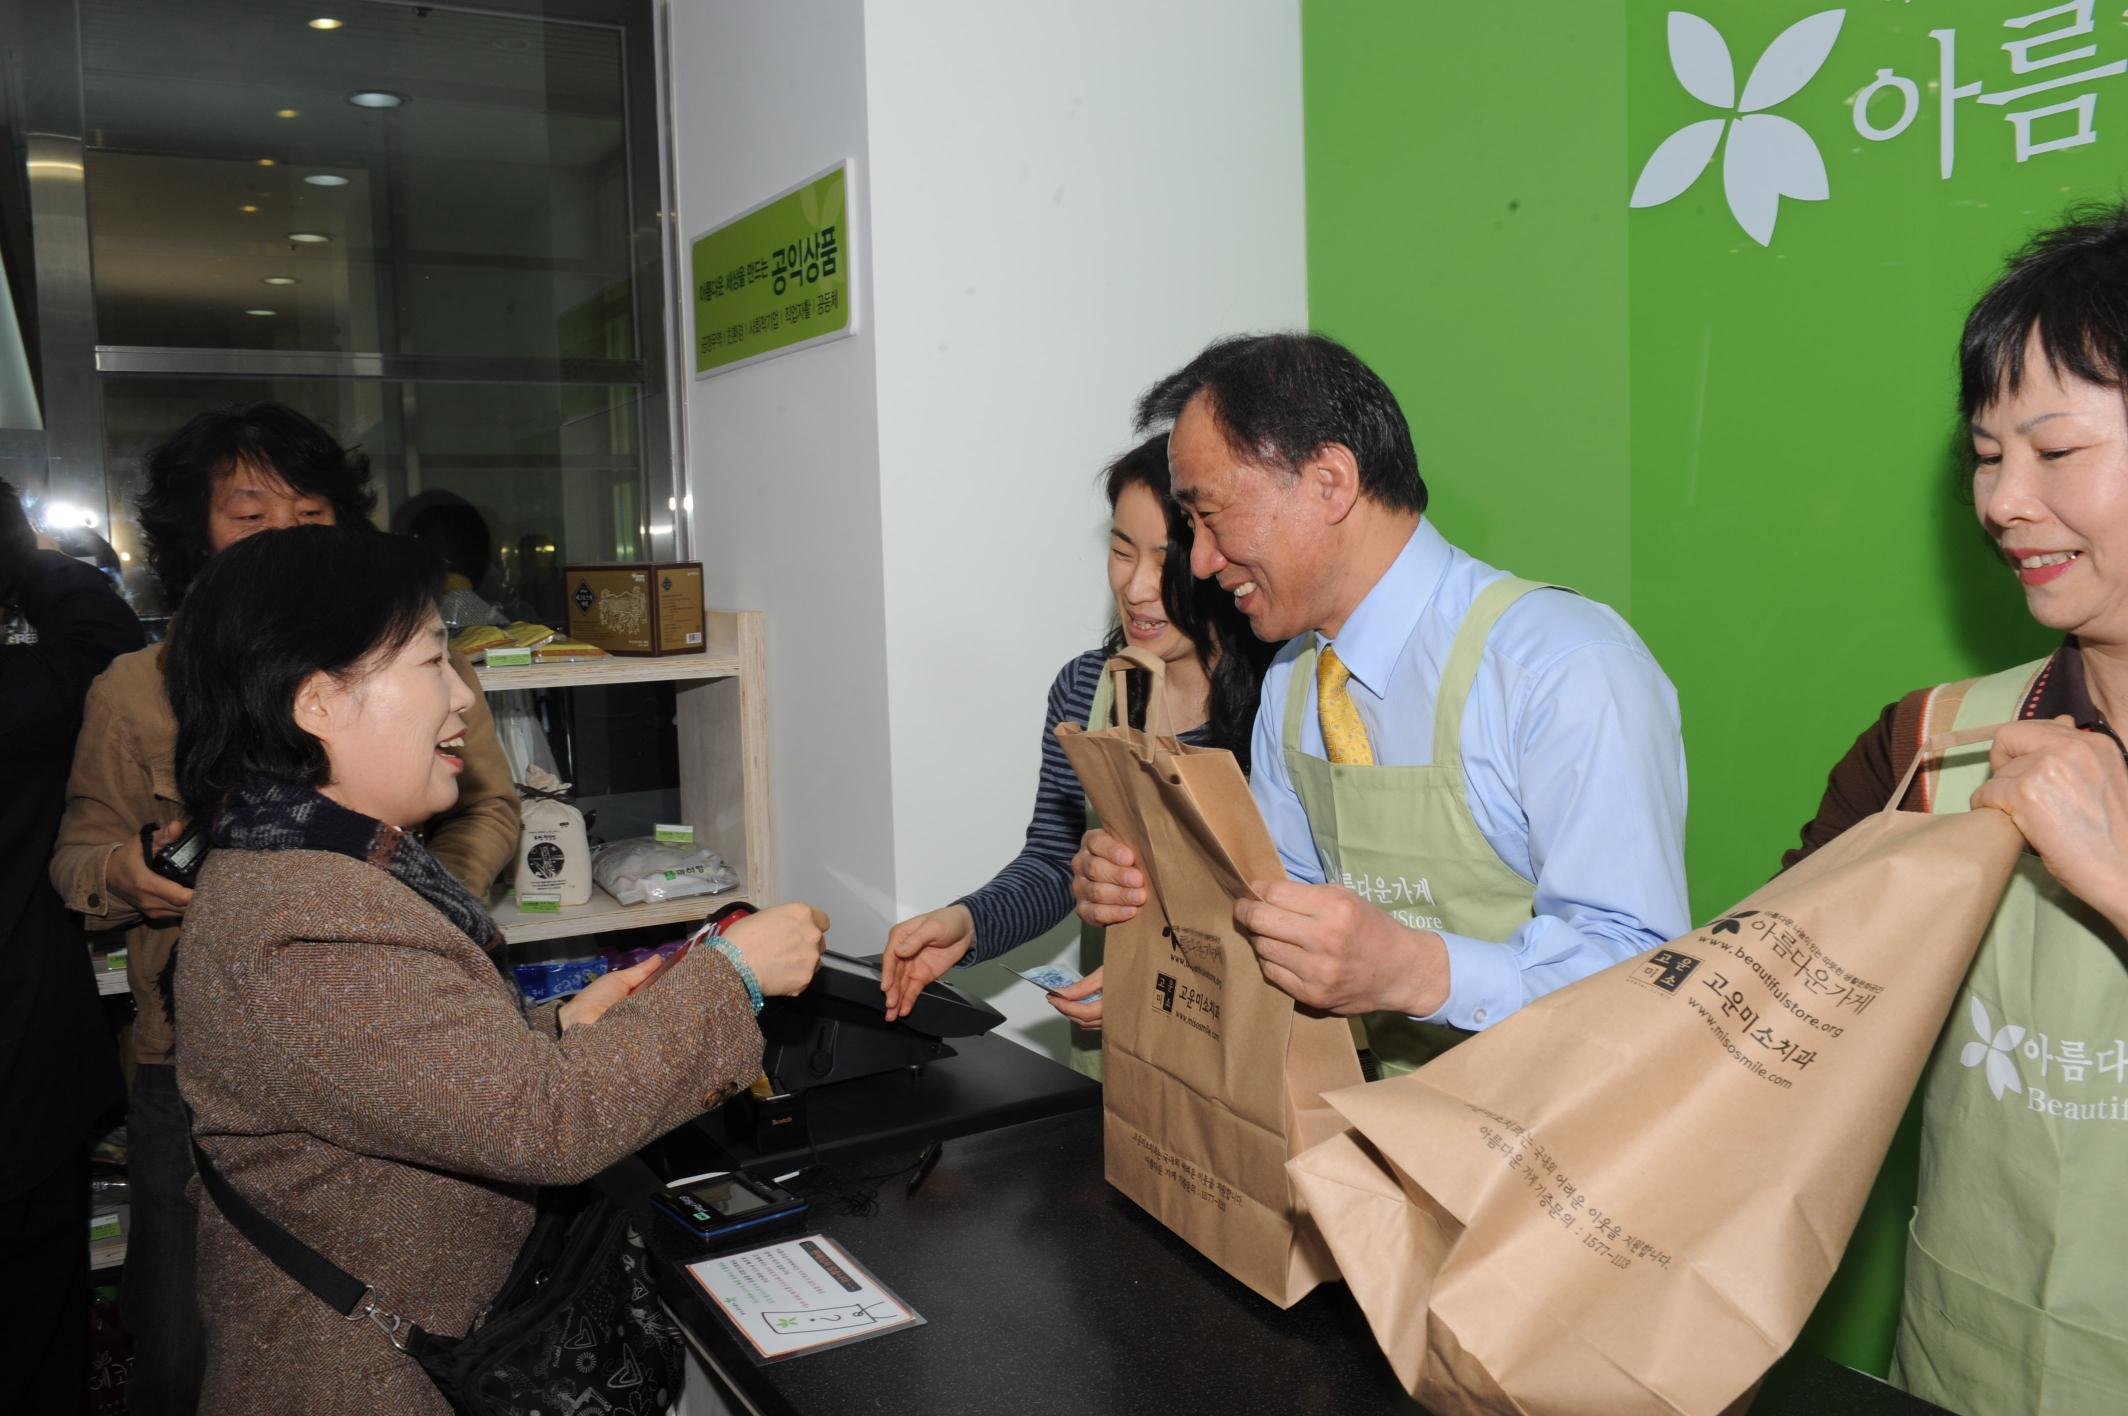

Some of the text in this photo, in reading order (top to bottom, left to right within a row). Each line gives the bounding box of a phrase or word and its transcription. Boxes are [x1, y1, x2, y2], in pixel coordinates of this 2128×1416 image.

[771, 225, 839, 297] 공익상품
[1179, 985, 1221, 1021] 고운미소치과
[1698, 935, 1845, 1039] www.beautifulstore.org
[1751, 920, 1877, 1016] 아름다운가게
[1688, 996, 1794, 1090] www.misosmile.com
[1702, 972, 1818, 1072] 고운미소치과
[1480, 1126, 1524, 1170] 아름다운
[1522, 1165, 1540, 1187] 가게
[1533, 1183, 1577, 1229] 기증문의
[1556, 1173, 1586, 1211] 어려운
[1588, 1207, 1622, 1241] 이웃을
